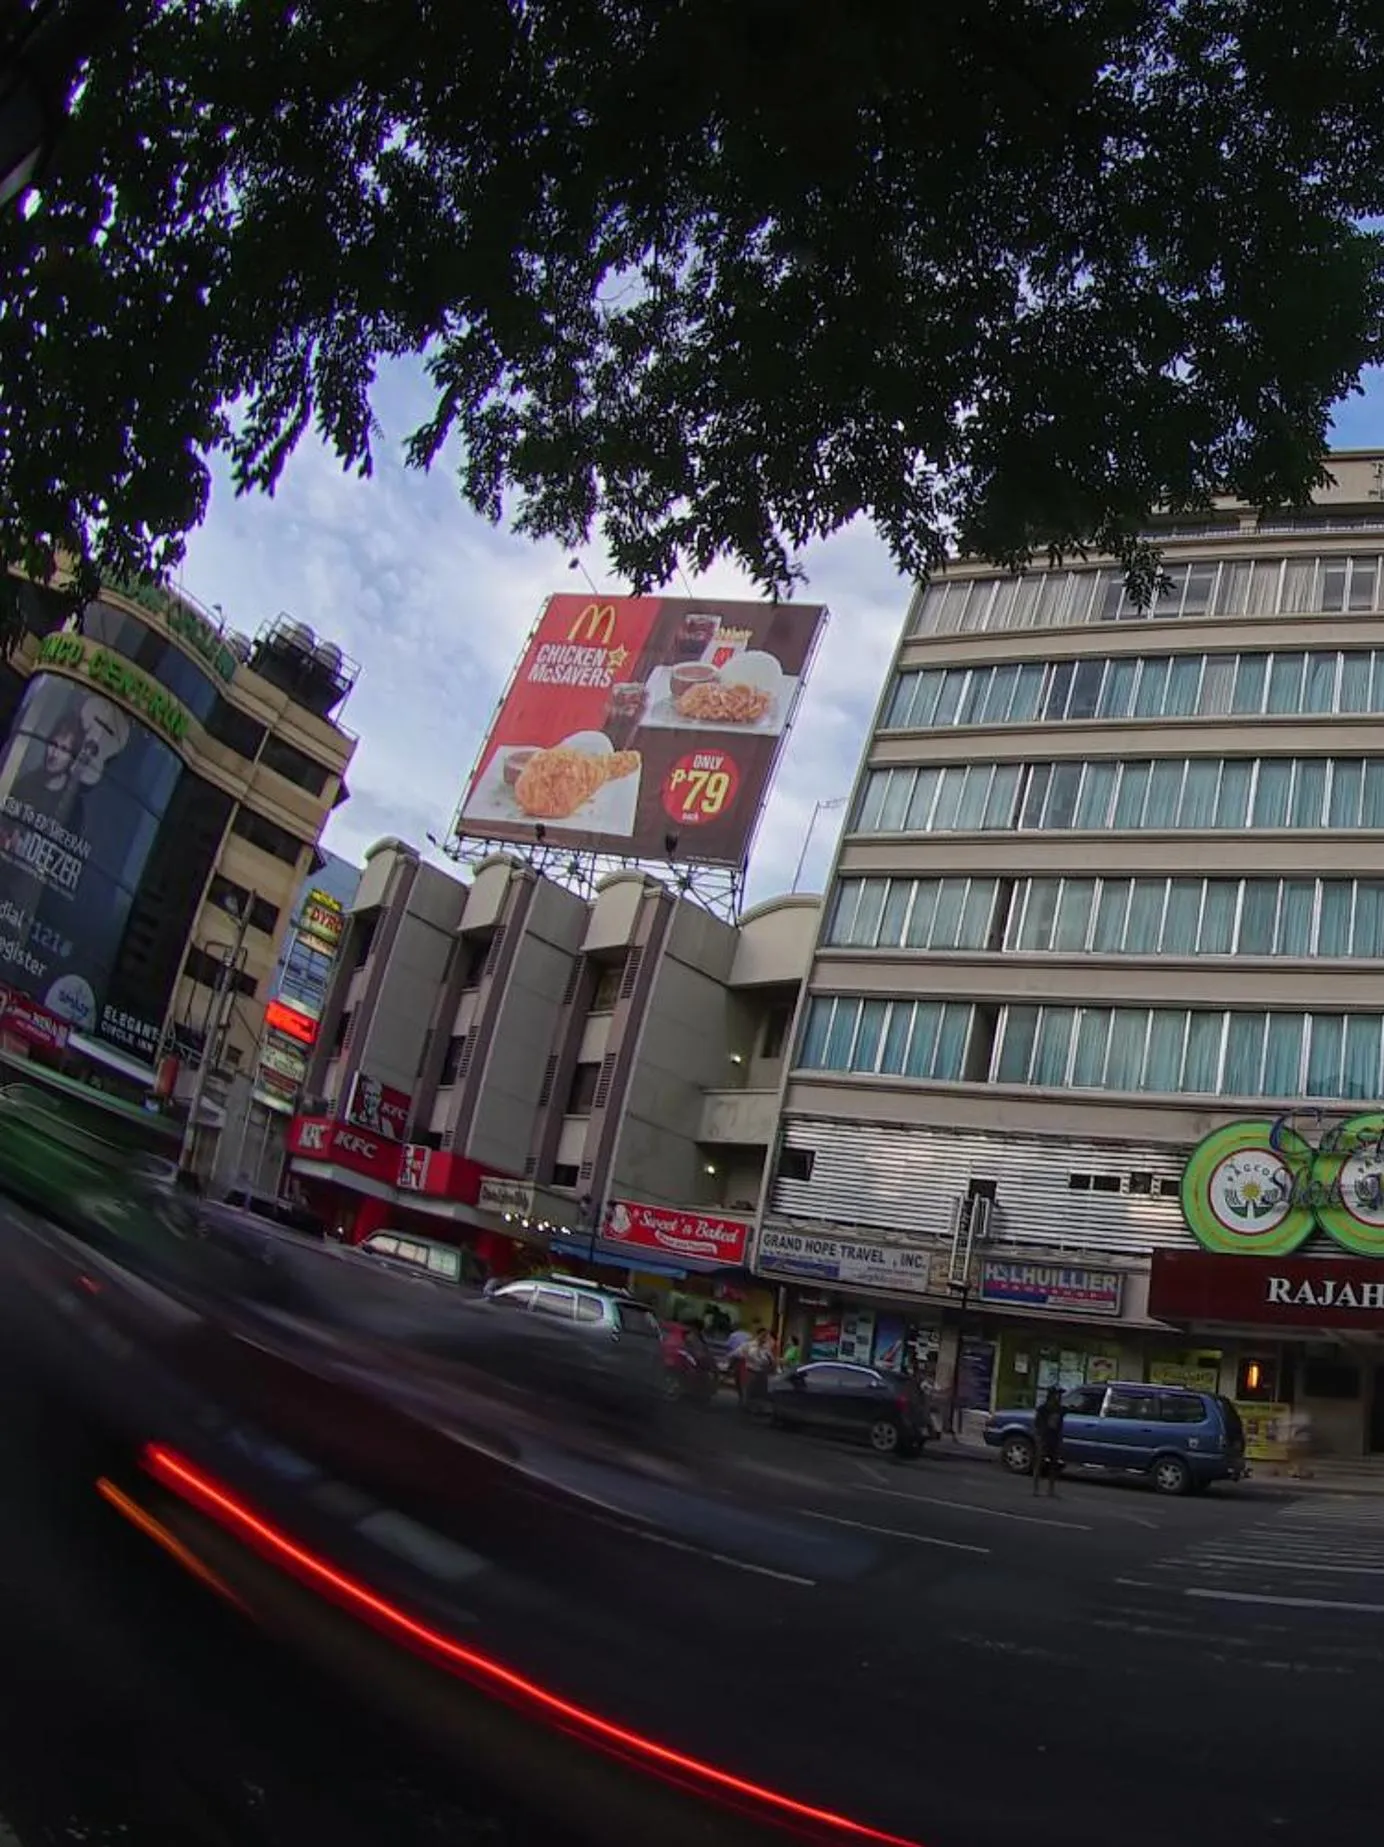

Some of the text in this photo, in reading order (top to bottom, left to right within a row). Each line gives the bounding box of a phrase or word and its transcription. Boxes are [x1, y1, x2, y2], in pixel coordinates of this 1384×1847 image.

[536, 643, 608, 668] CHICKEN
[693, 754, 725, 770] ONLY
[26, 831, 82, 891] DEEZER
[103, 1004, 162, 1042] ELEGANT
[333, 1130, 379, 1159] KFC
[694, 1220, 740, 1243] Baked
[763, 1232, 802, 1251] GRAND
[805, 1238, 838, 1257] HOPE
[840, 1244, 887, 1265] TRAVEL
